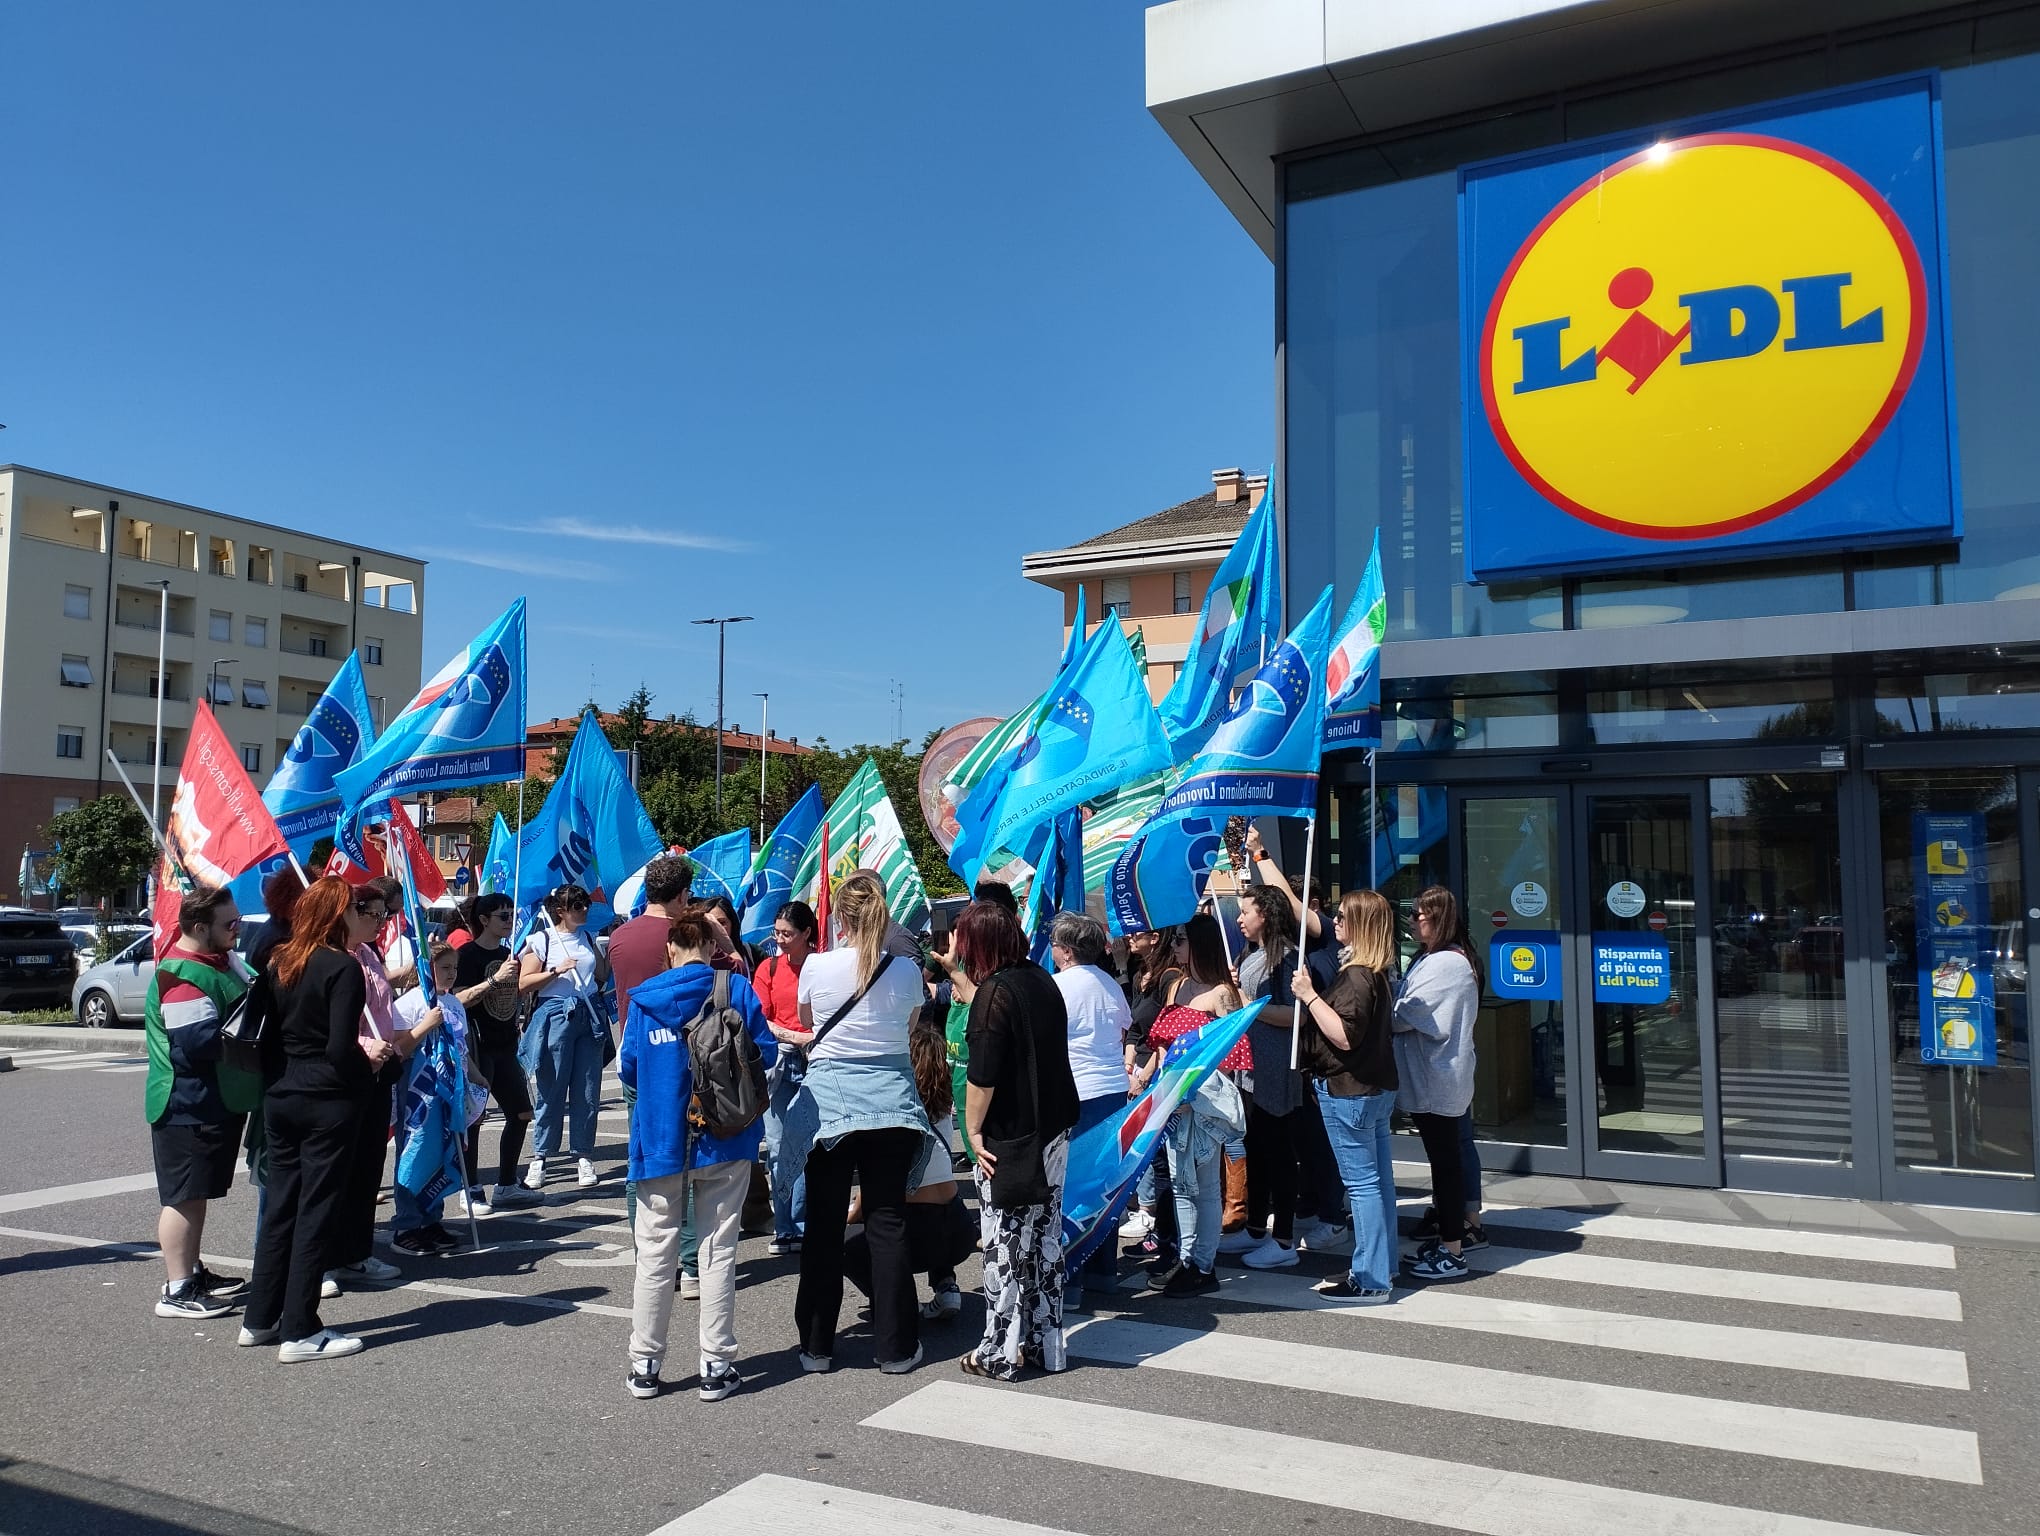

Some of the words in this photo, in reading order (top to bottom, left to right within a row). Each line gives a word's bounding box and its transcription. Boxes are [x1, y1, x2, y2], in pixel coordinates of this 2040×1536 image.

[1599, 949, 1663, 961] Risparmia
[1599, 961, 1612, 973] di
[1615, 964, 1636, 975] più
[1638, 964, 1663, 974] con
[1513, 973, 1535, 983] Plus
[1600, 975, 1623, 986] Lidl
[1626, 976, 1659, 987] Plus!
